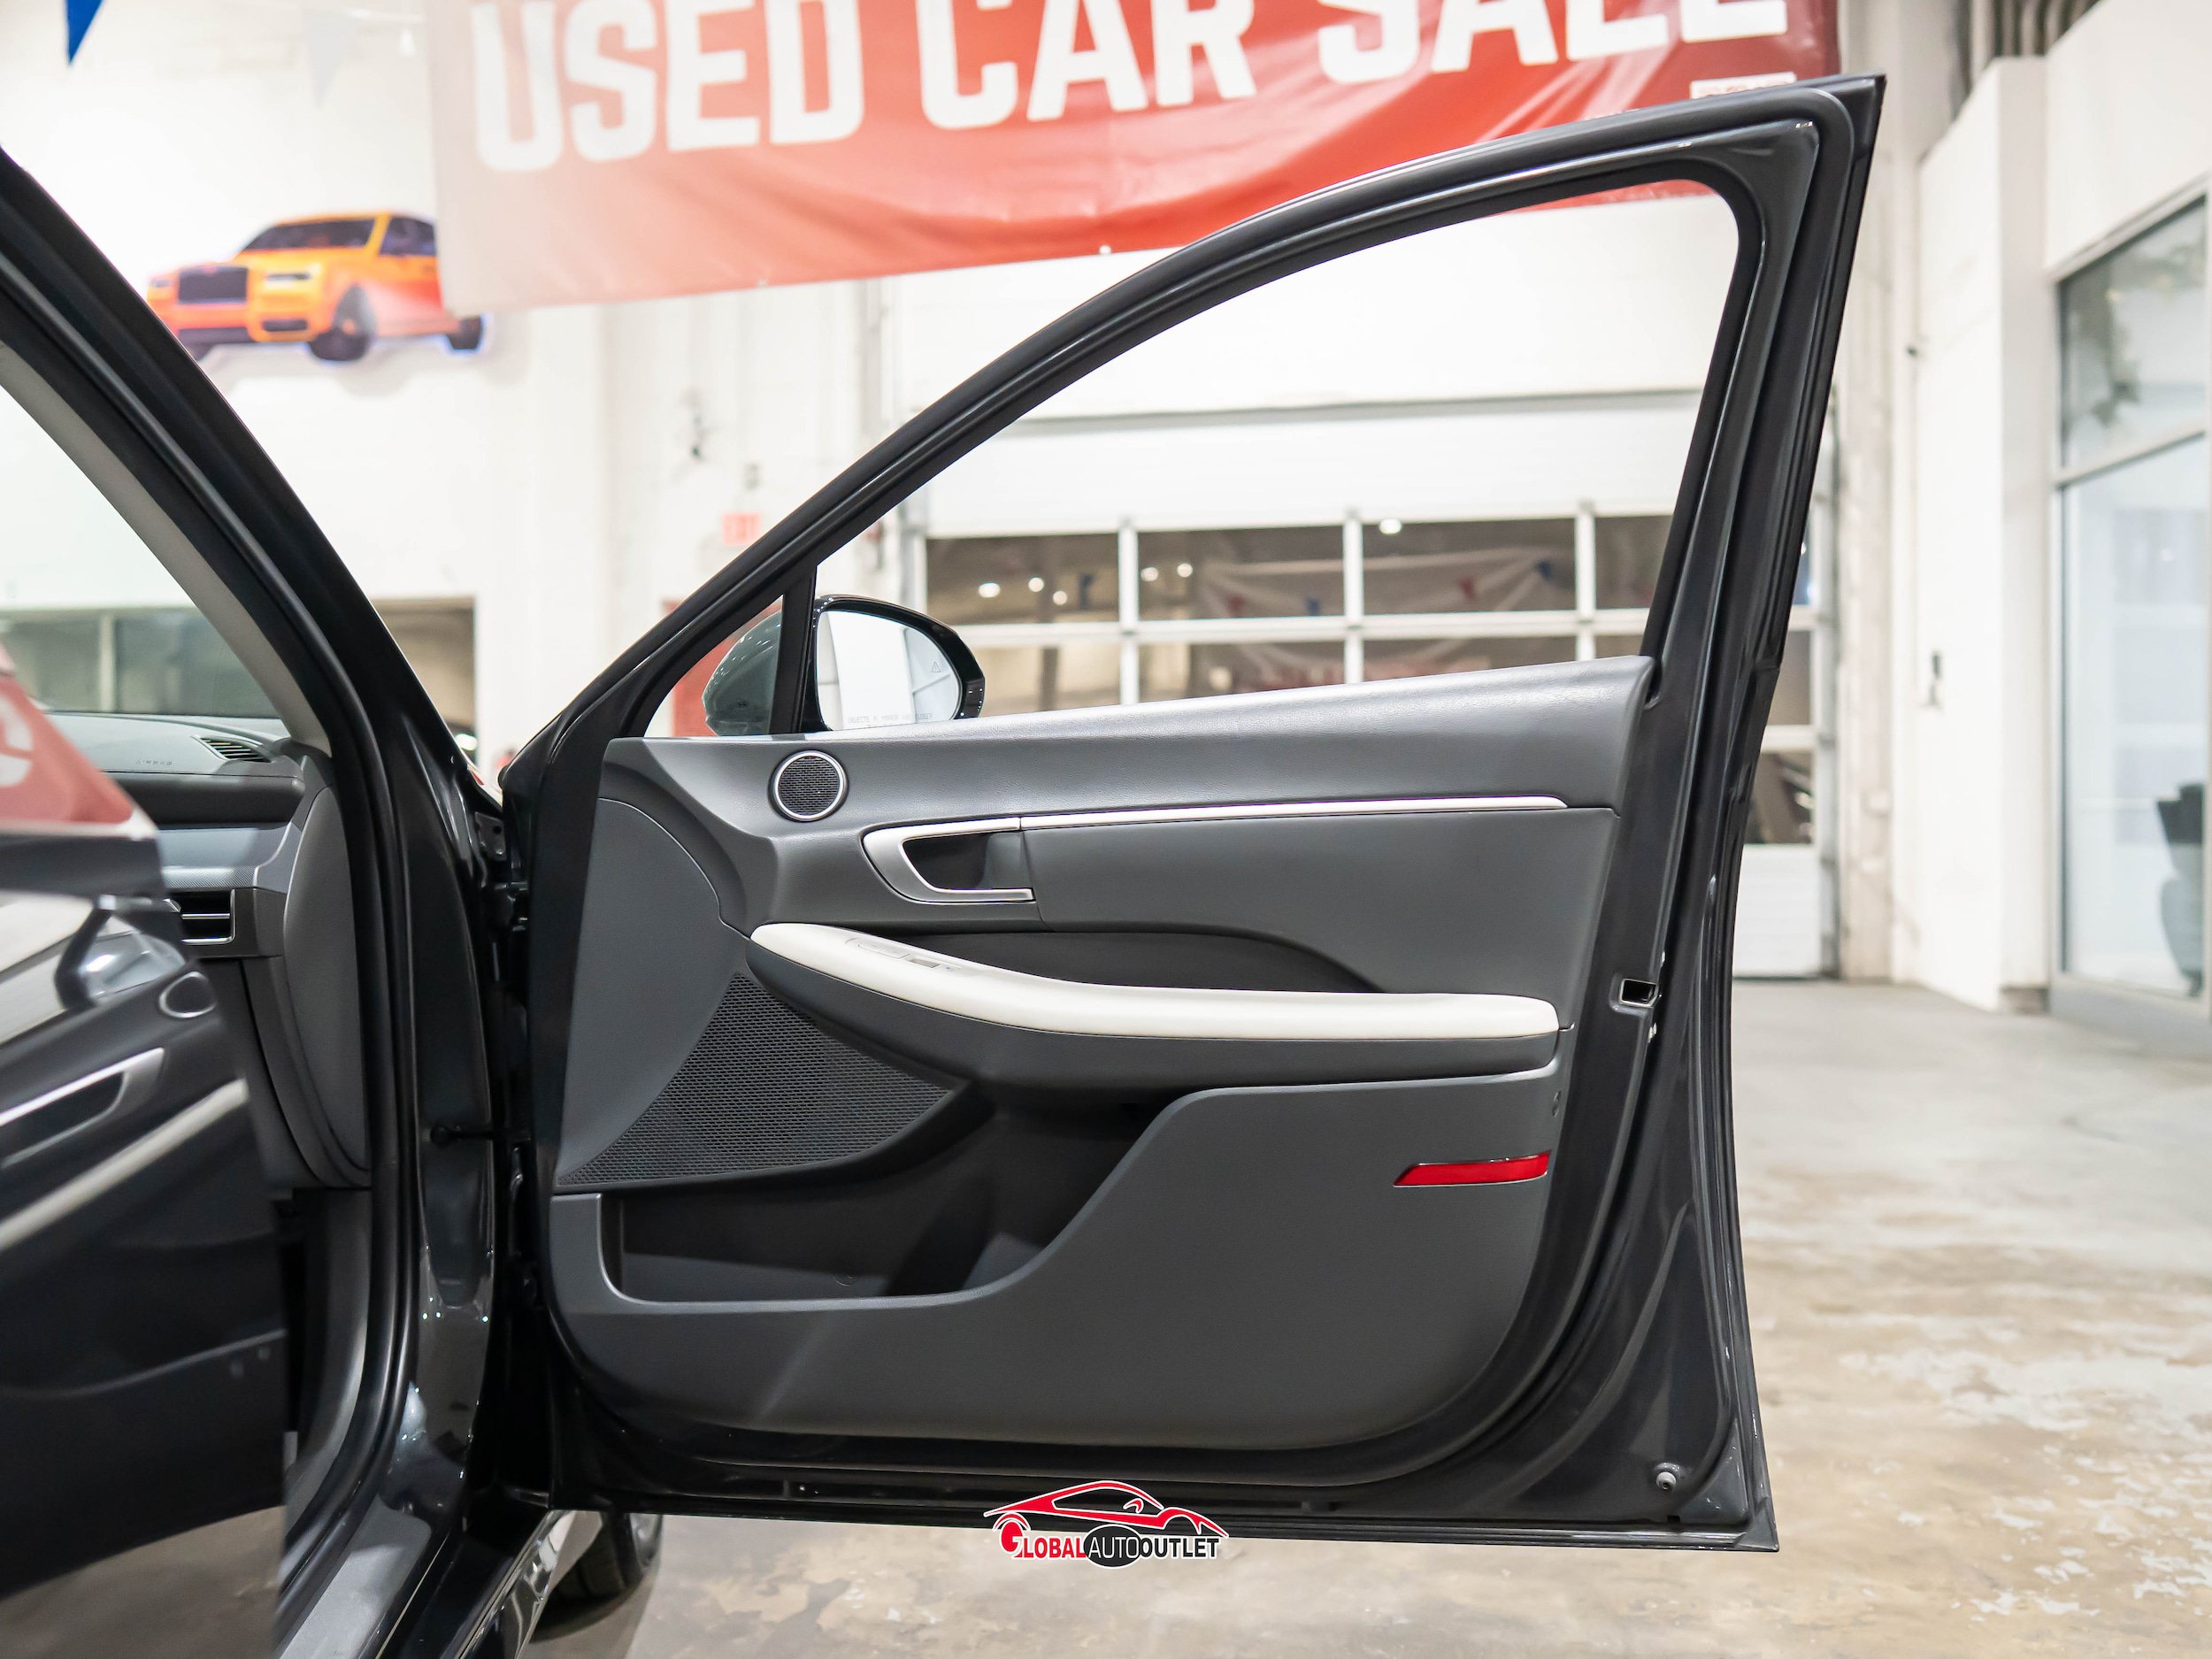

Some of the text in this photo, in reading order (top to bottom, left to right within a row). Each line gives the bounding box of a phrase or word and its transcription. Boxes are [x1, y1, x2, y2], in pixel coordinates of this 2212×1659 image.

[472, 0, 1787, 171] USED CAR SA
